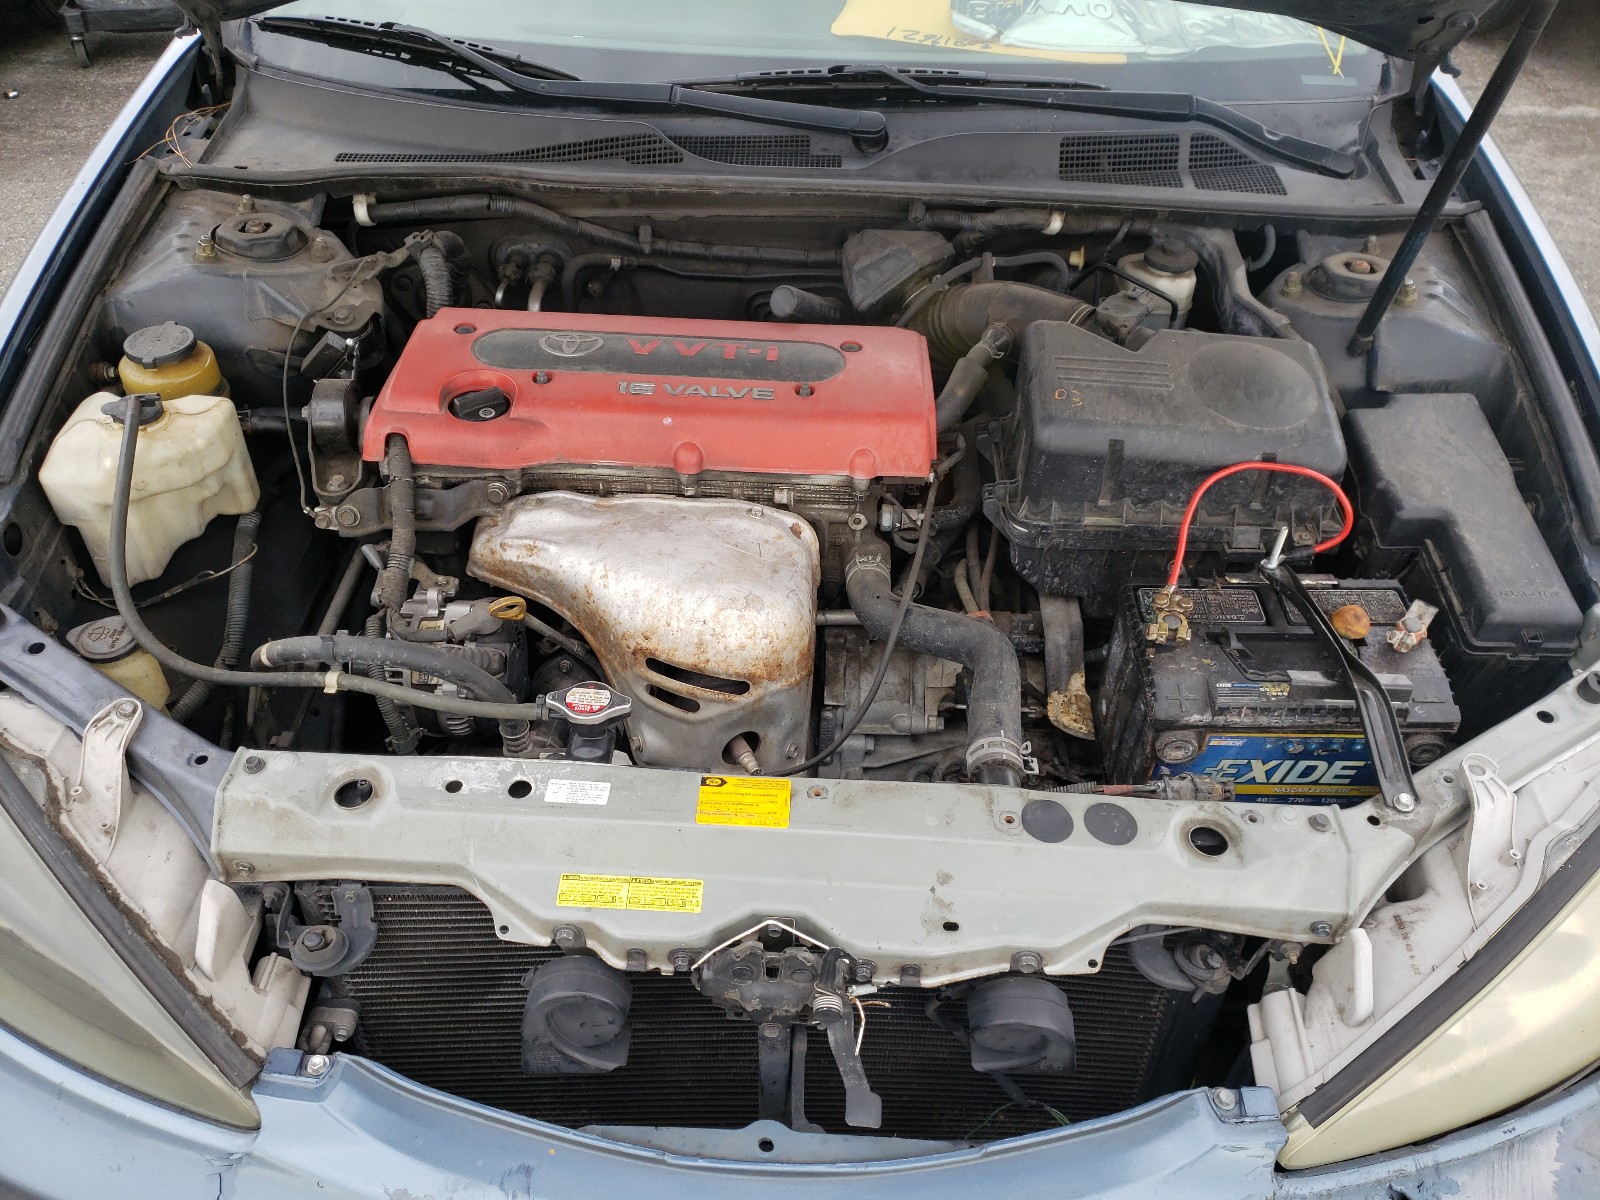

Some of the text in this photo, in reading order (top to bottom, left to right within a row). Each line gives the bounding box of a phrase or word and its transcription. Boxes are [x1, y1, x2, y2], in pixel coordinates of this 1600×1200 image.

[617, 381, 775, 400] 16 VALVE
[1203, 759, 1366, 785] EXIDE
